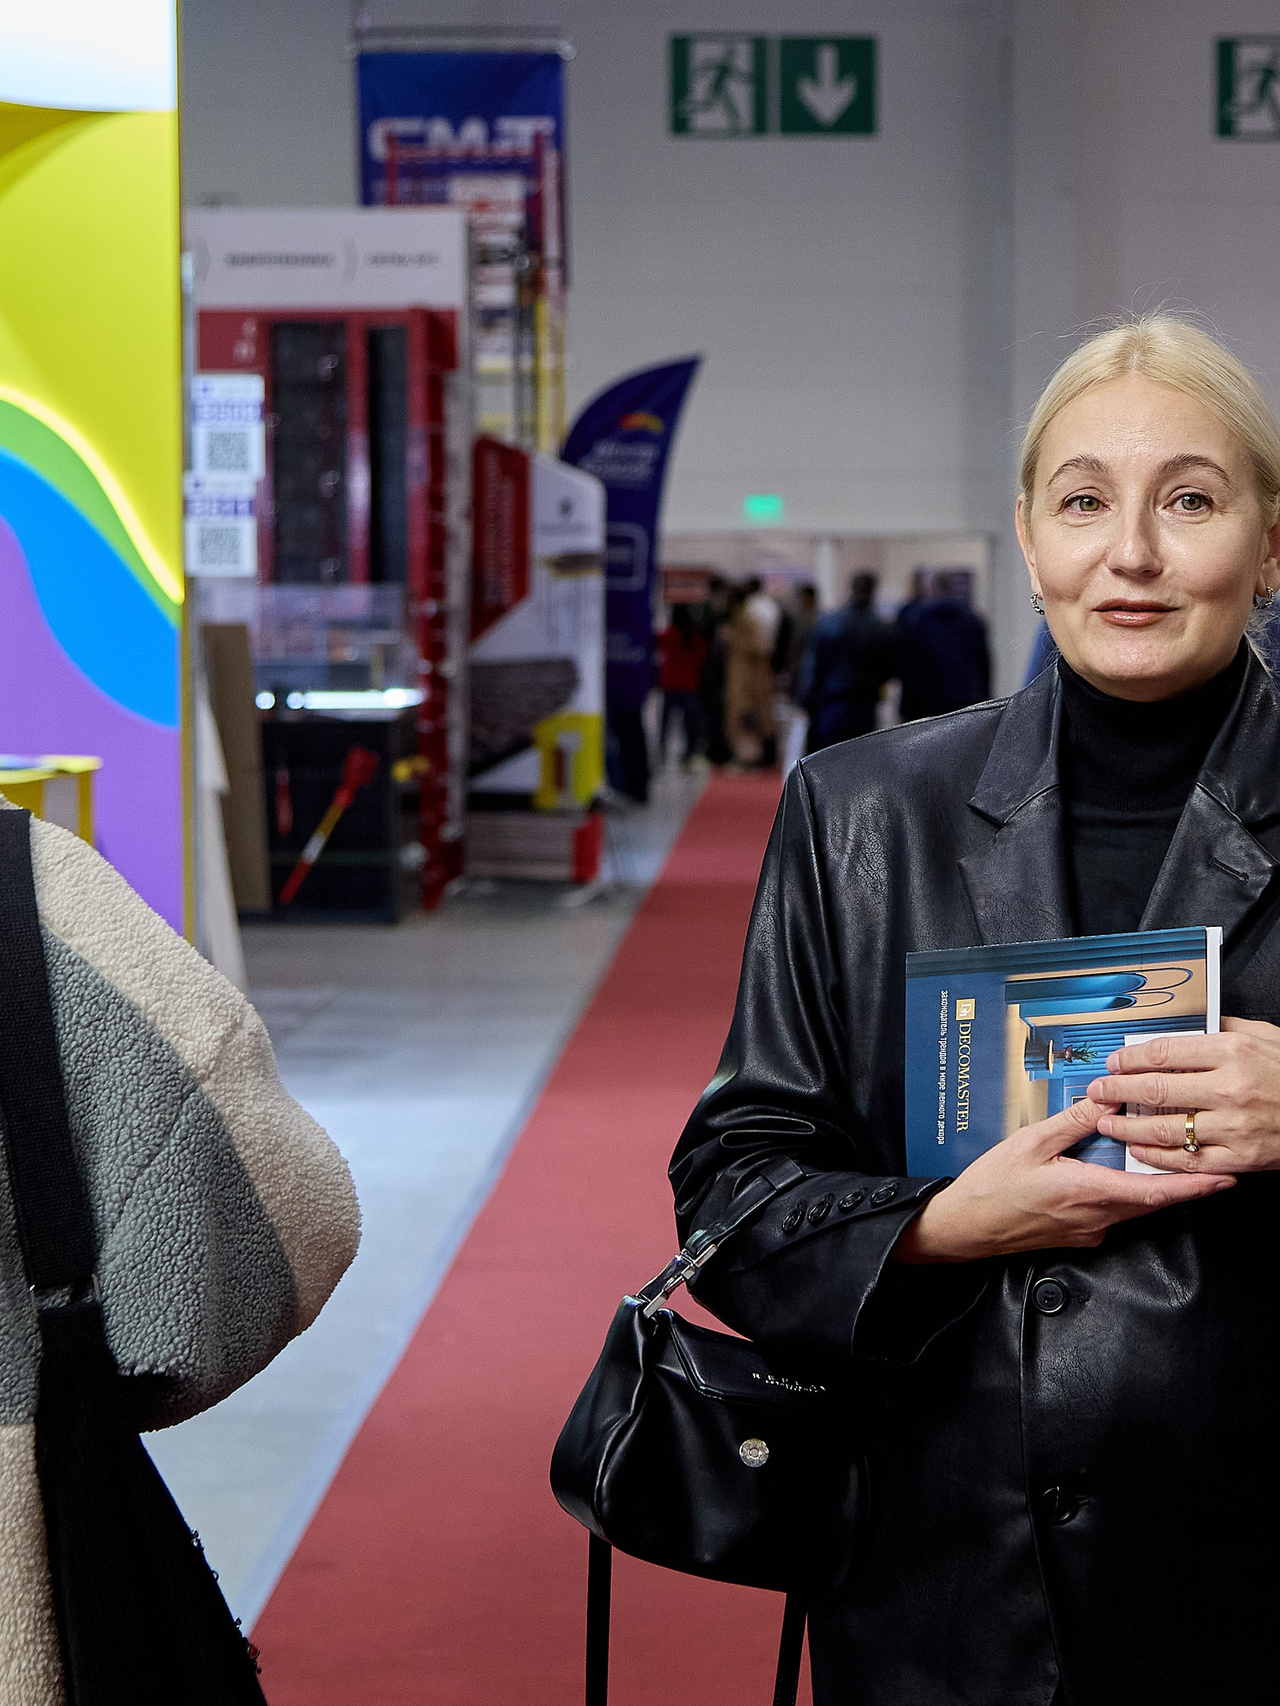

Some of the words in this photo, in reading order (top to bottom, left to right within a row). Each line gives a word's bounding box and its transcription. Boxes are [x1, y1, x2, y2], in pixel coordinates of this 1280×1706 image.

[940, 990, 949, 1037] законодатель
[938, 1037, 948, 1065] трендов
[938, 1073, 947, 1090] мире
[956, 1022, 972, 1133] DECOMASTER
[936, 1120, 945, 1145] декора
